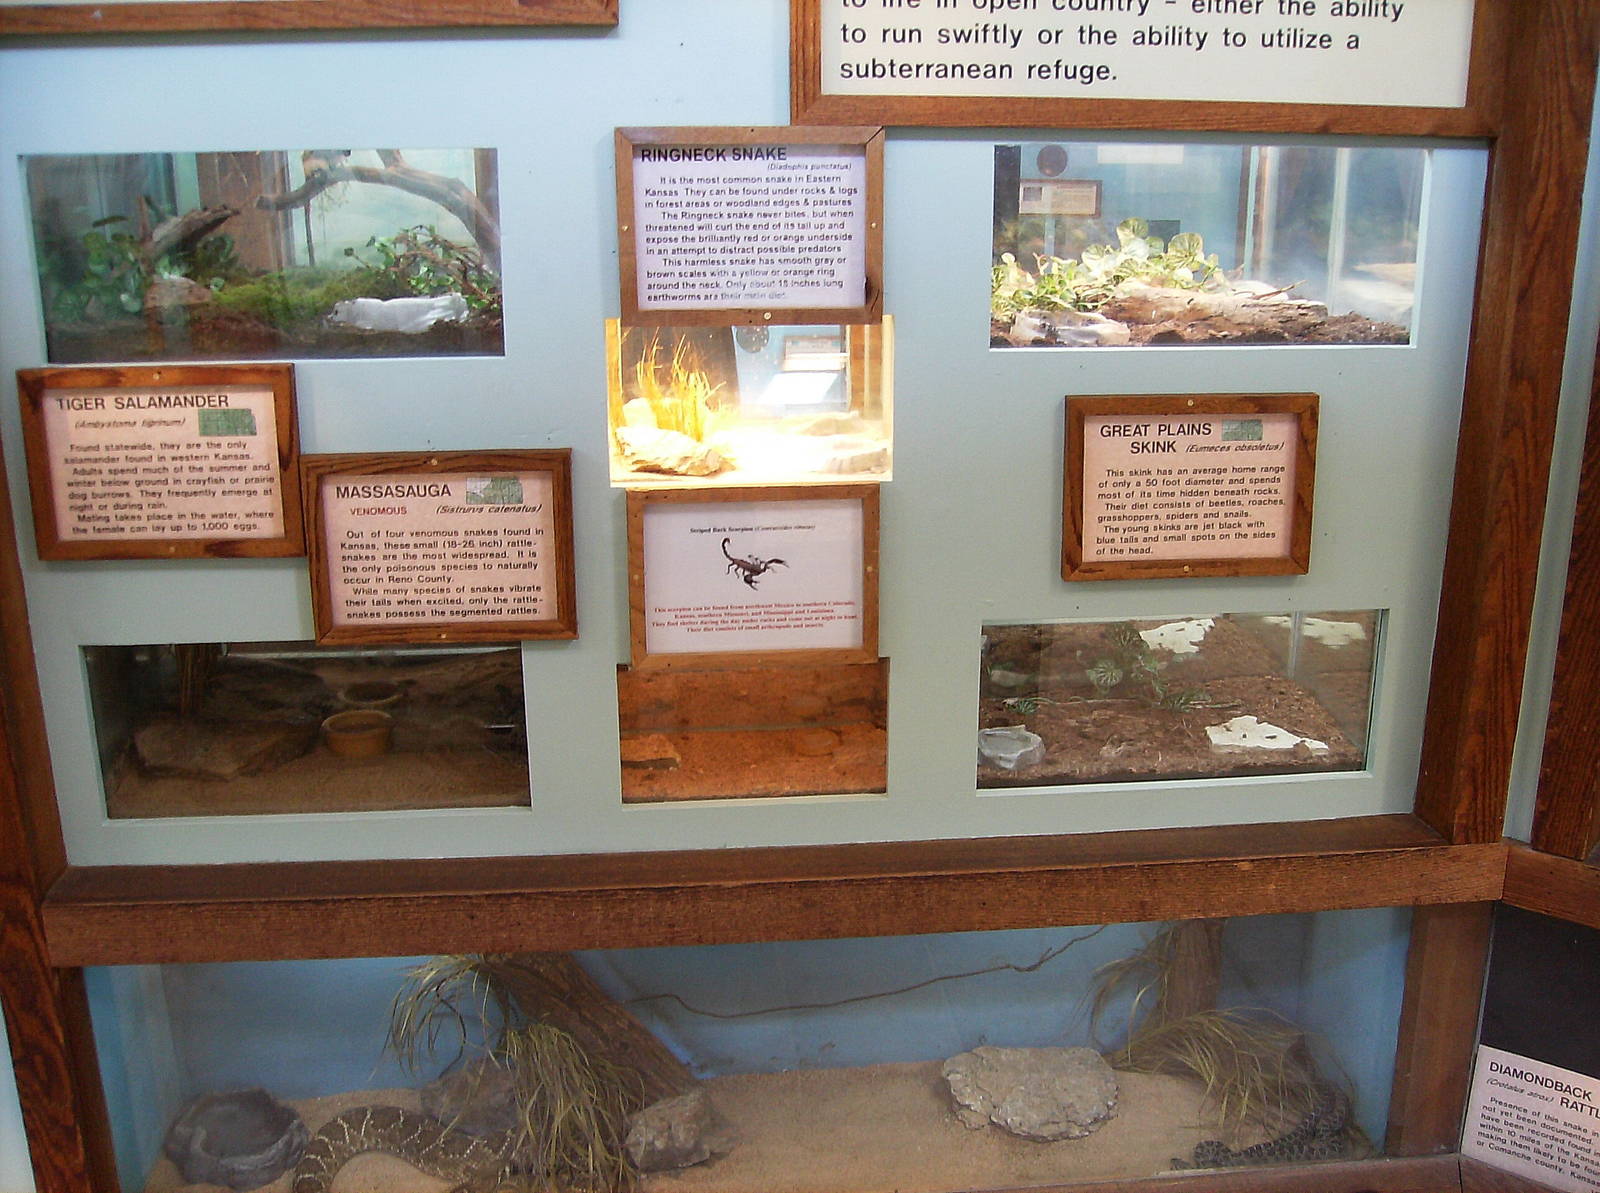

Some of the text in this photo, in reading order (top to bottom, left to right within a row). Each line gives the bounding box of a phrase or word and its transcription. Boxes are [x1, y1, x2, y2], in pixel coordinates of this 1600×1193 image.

[973, 0, 1036, 13] open
[1052, 0, 1149, 16] country
[1192, 0, 1263, 14] either
[1278, 0, 1315, 17] the
[1330, 0, 1404, 22] ability
[841, 23, 1359, 51] to run swiftly or the ability to utilize a
[840, 59, 1117, 85] subterranean refuge.
[641, 147, 786, 162] RINGNECK SNAKE
[723, 176, 762, 184] common
[766, 175, 792, 183] snake
[796, 175, 803, 183] in
[806, 175, 841, 183] Eastern
[685, 188, 706, 197] They
[743, 187, 768, 195] found
[772, 187, 797, 195] under
[839, 187, 857, 196] logs
[656, 200, 682, 208] forest
[773, 200, 800, 208] edges
[56, 395, 228, 410] TIGER SALAMANDER
[1100, 423, 1212, 437] GREAT PLAINS
[160, 442, 180, 450] they
[227, 441, 246, 449] only
[1130, 441, 1285, 454] SKINK (Eumeces obsoletus)
[1106, 469, 1124, 477] This
[1261, 466, 1285, 474] range
[1112, 480, 1131, 488] only
[1229, 477, 1244, 485] and
[1249, 476, 1280, 485] spends
[336, 484, 451, 498] MASSASAUGA
[1180, 489, 1209, 497] hidden
[1214, 488, 1249, 496] beneath
[350, 506, 407, 515] VENOMOUS
[488, 504, 542, 513] catenatus)
[347, 530, 363, 538] Out
[371, 530, 380, 538] of
[386, 530, 404, 538] four
[410, 529, 458, 537] venomous
[341, 539, 536, 550] Kansas, these small (18-26 inch) rattle-
[452, 551, 509, 560] widespread.
[518, 550, 523, 558] It
[450, 608, 502, 617] segmented
[1489, 1061, 1592, 1101] DIAMONDBACK
[1490, 1097, 1528, 1113] Presence
[1545, 1114, 1559, 1123] this
[1564, 1121, 1588, 1133] snake
[1483, 1105, 1496, 1113] not
[1517, 1115, 1536, 1125] been
[1541, 1122, 1593, 1144] documented.
[1480, 1123, 1503, 1133] within
[1520, 1134, 1541, 1145] miles
[1481, 1113, 1499, 1123] have
[1504, 1120, 1524, 1130] been
[1528, 1128, 1565, 1144] recorded
[1568, 1141, 1591, 1154] found
[1489, 1143, 1531, 1161] Comanche
[1535, 1159, 1565, 1174] county.
